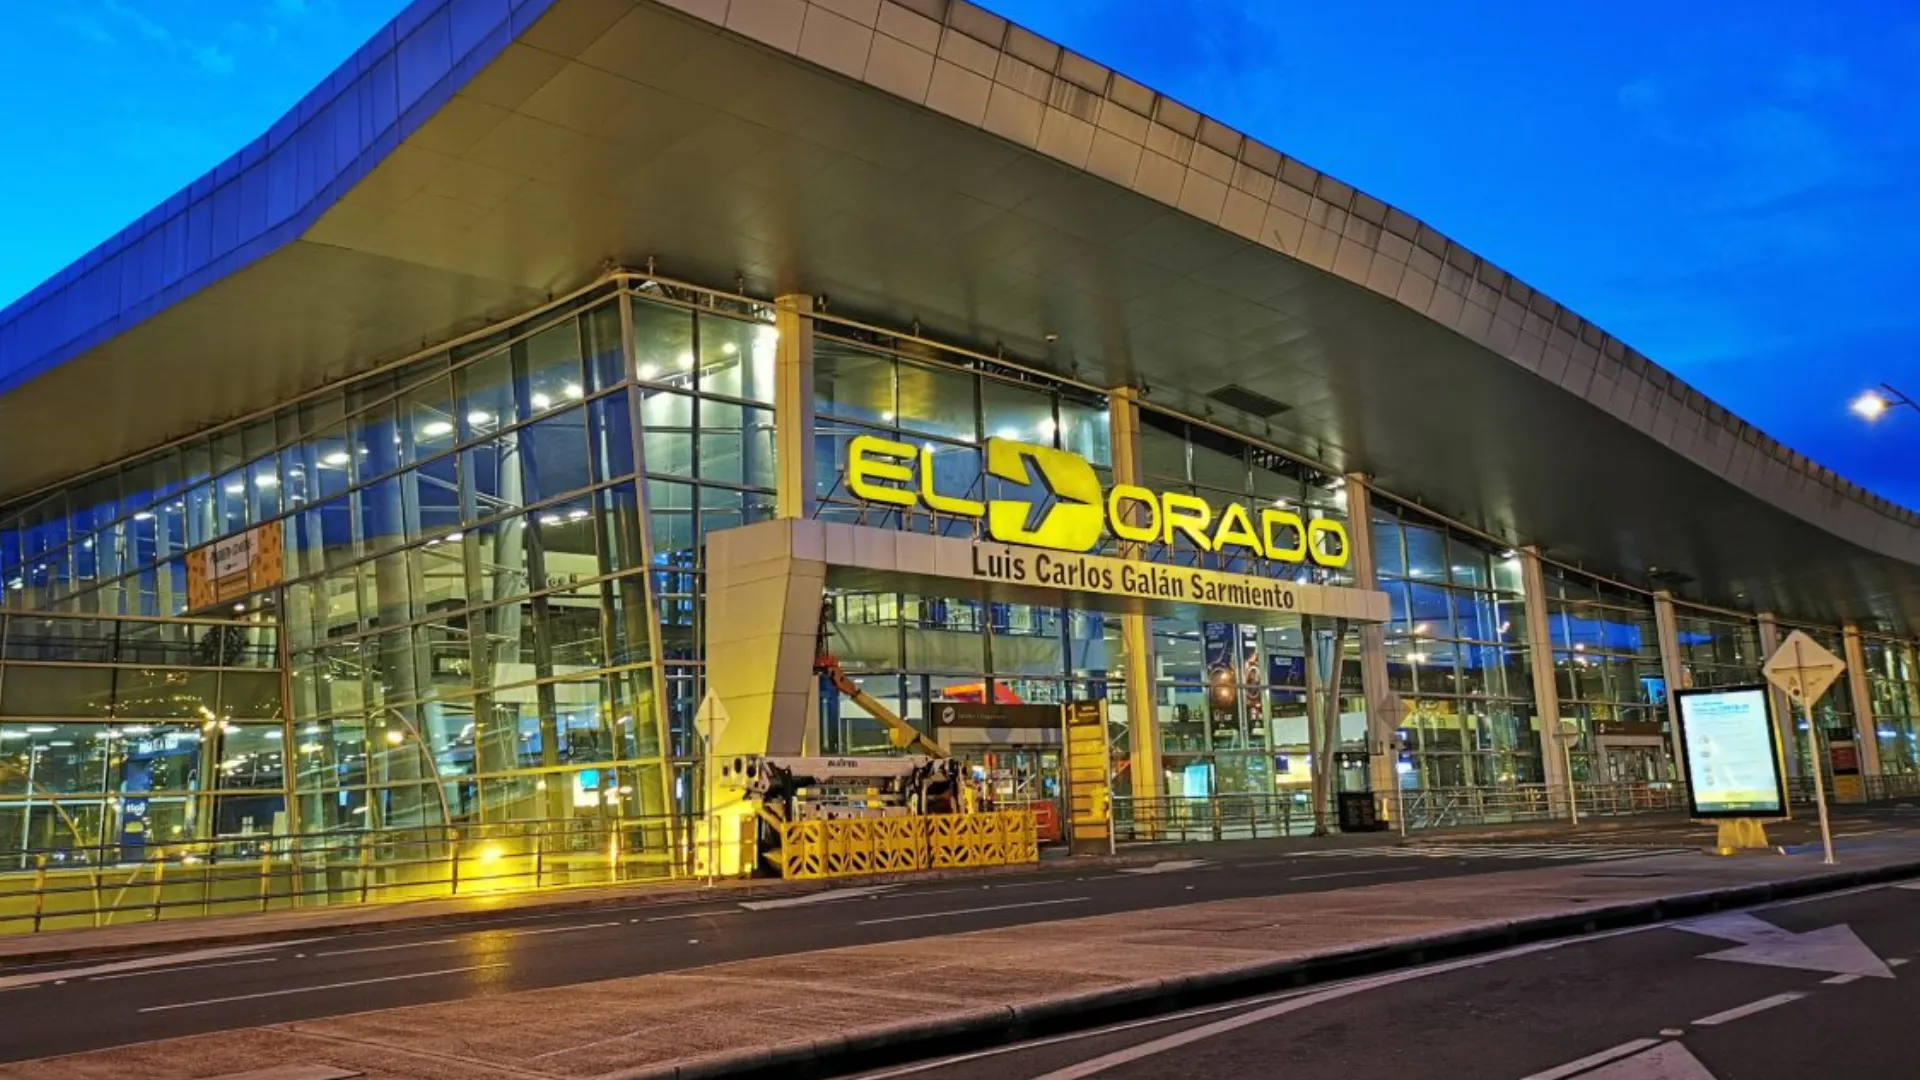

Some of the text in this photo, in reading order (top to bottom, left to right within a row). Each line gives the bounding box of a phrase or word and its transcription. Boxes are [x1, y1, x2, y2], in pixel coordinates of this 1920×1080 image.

[847, 434, 986, 517] EL
[972, 545, 1295, 609] Luis Carlos Galán Sarmiento
